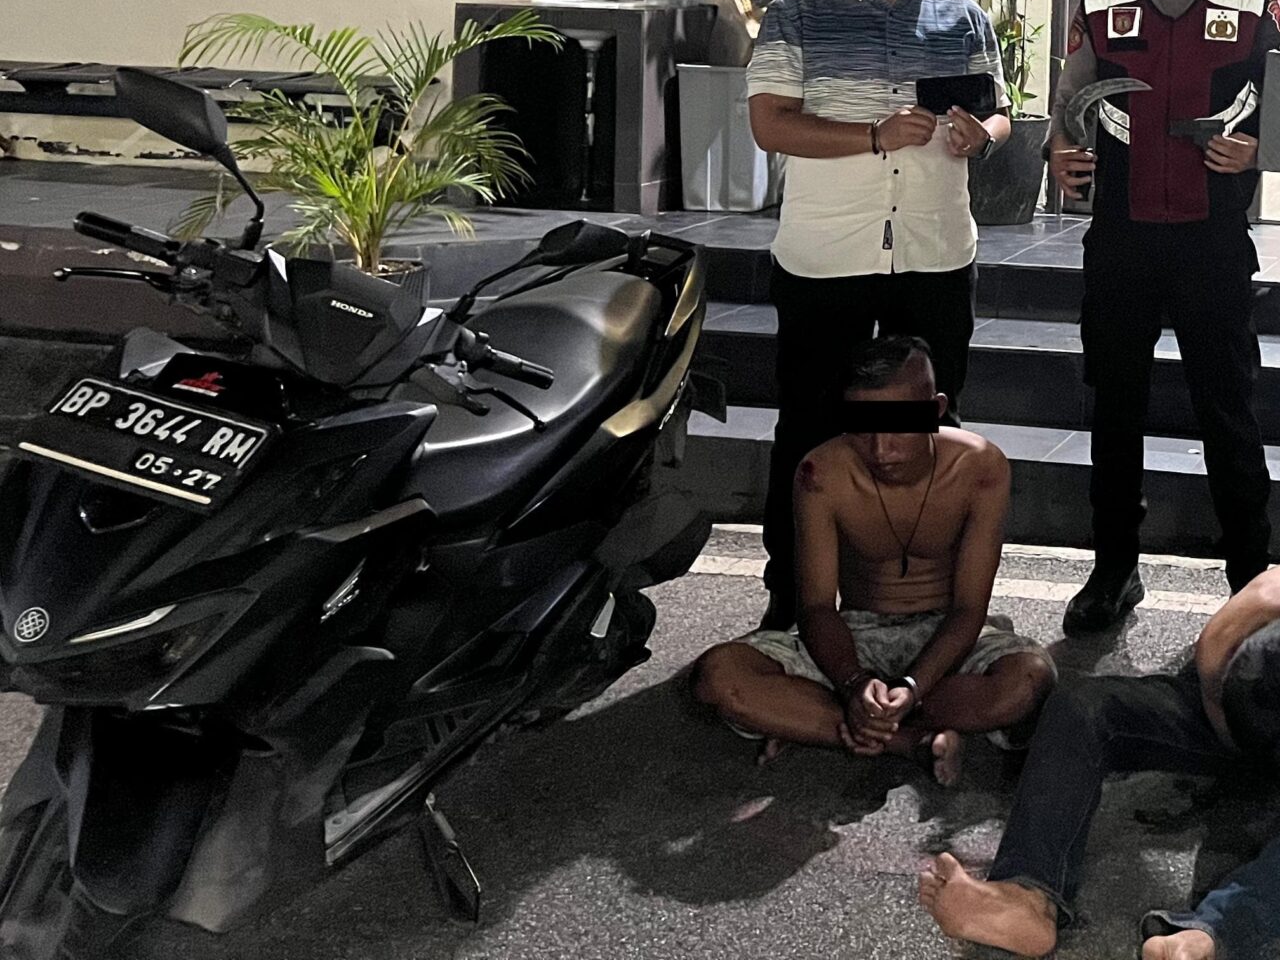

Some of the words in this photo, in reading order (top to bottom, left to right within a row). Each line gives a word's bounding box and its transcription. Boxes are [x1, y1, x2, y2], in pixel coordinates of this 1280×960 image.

[60, 386, 111, 416] BP
[115, 402, 202, 444] 3644
[201, 426, 256, 463] RM
